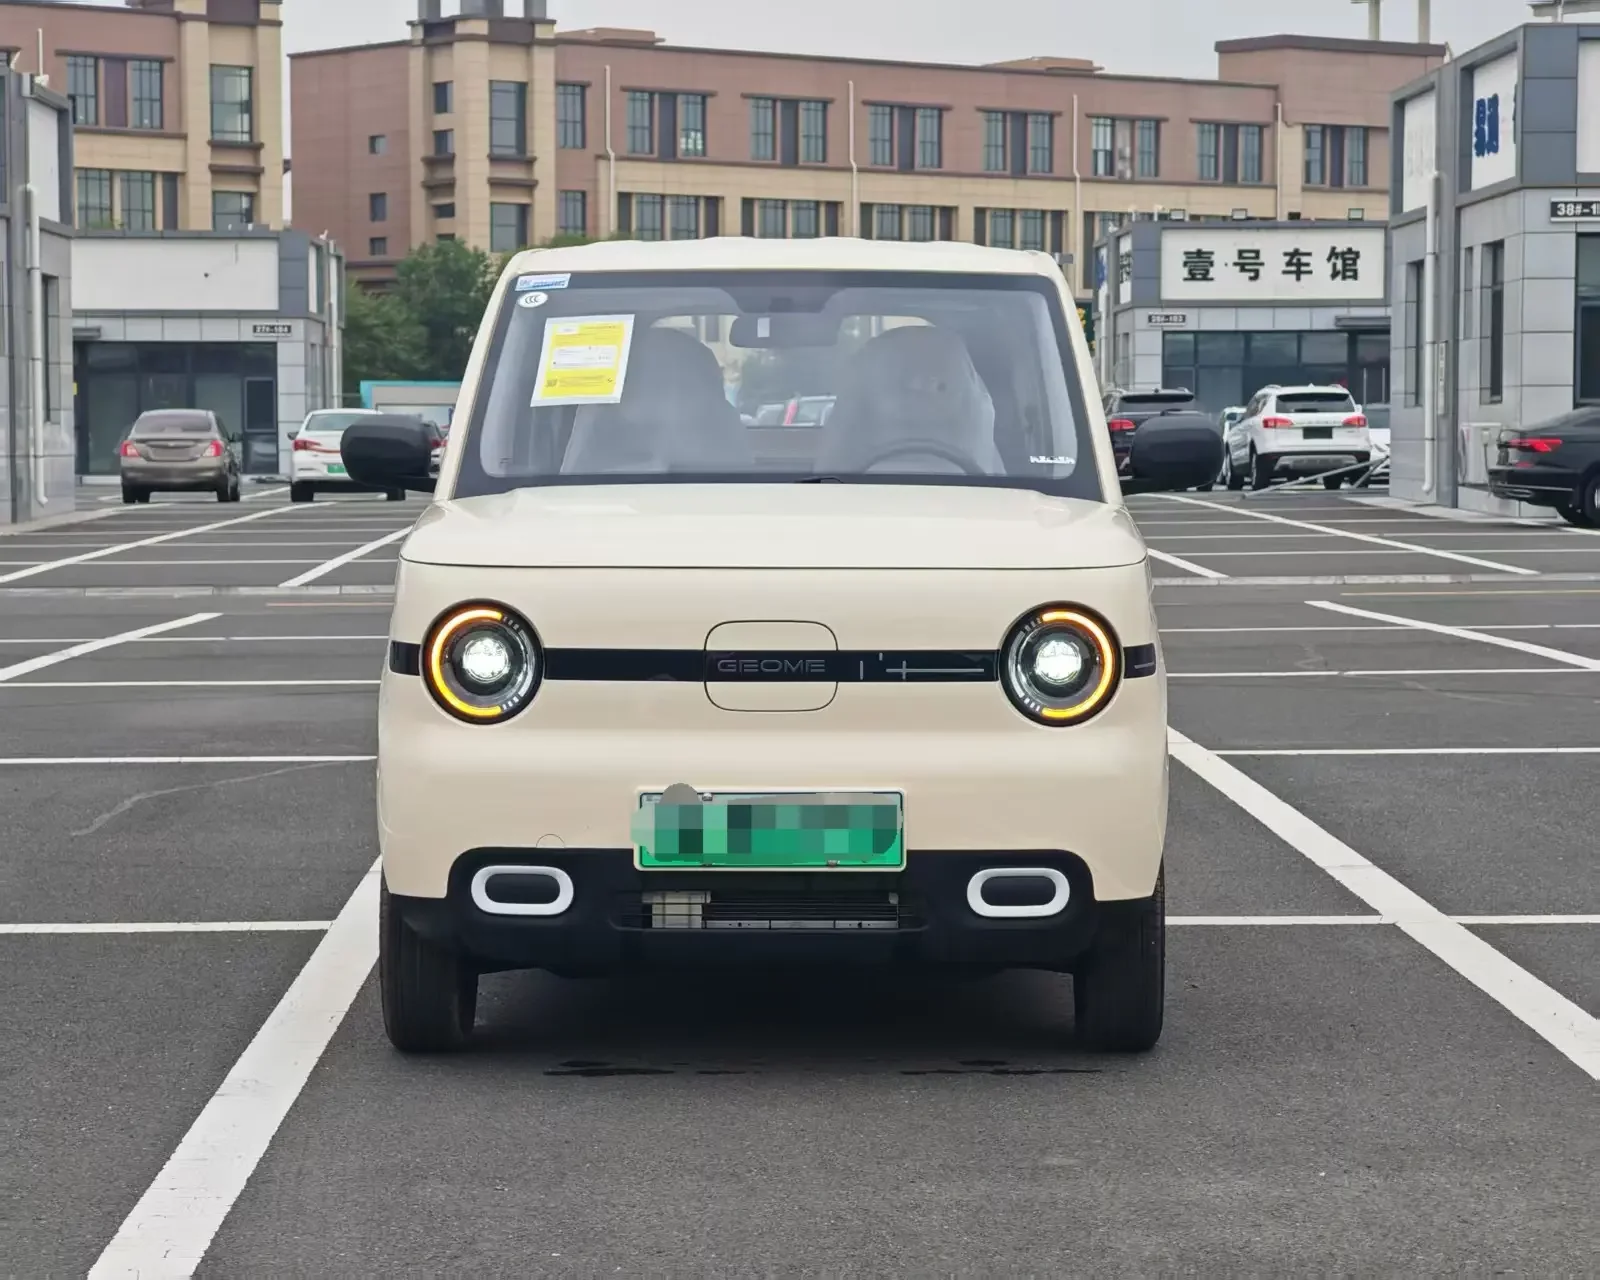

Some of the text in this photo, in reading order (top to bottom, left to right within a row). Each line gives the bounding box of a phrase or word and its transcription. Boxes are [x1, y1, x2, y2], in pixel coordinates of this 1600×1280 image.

[1183, 246, 1361, 282] 壹号车馆
[717, 659, 826, 673] GEOME
